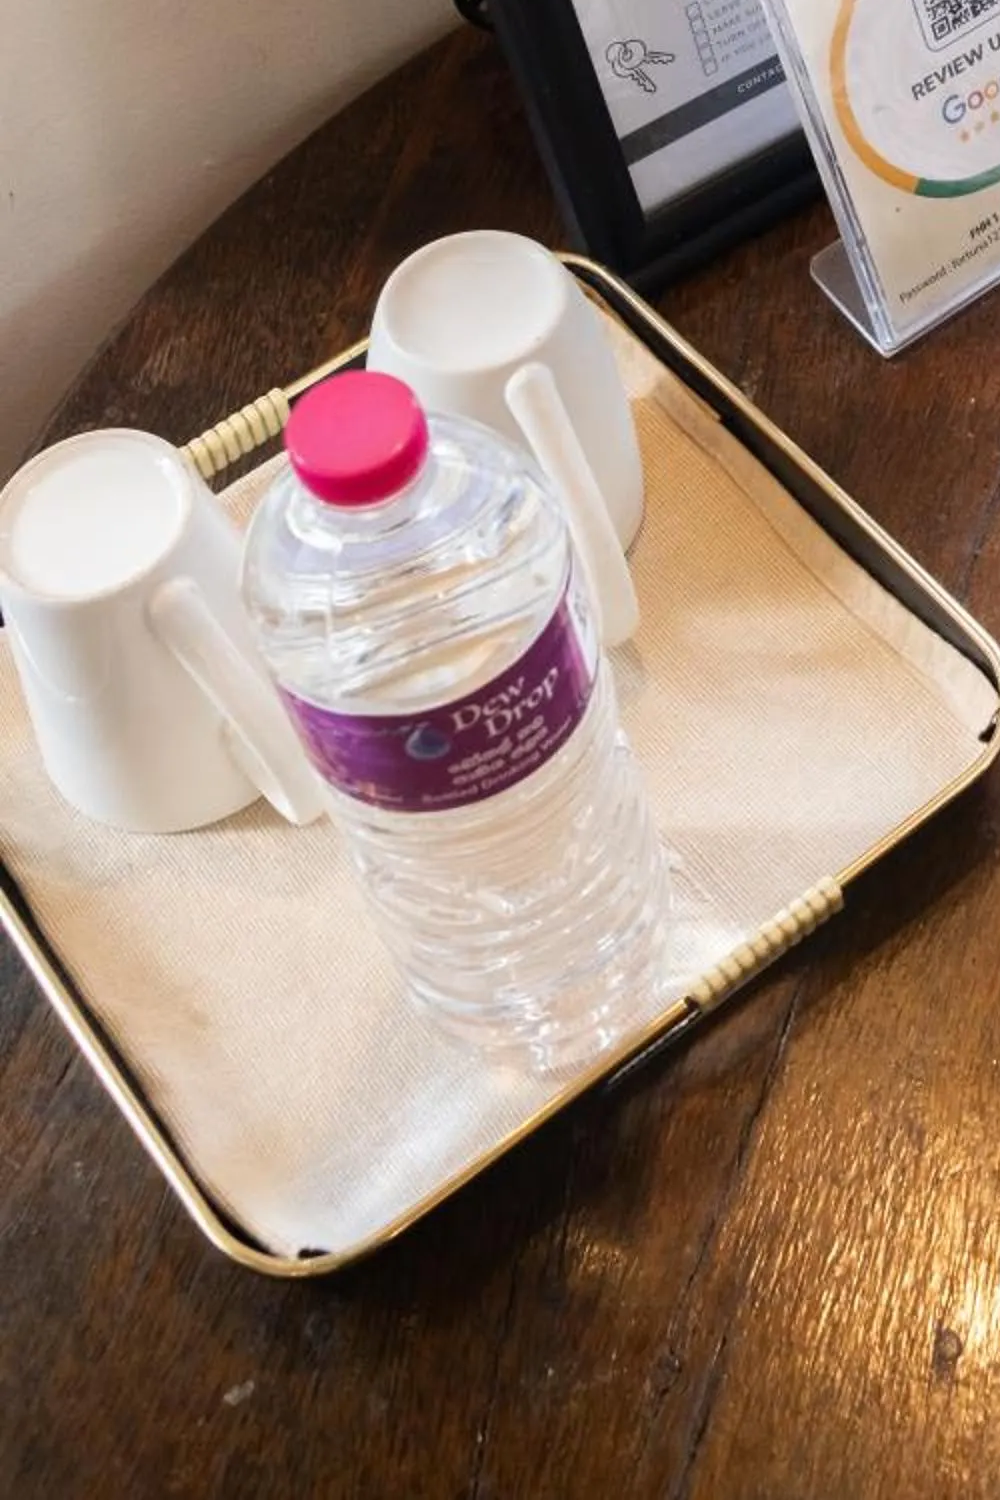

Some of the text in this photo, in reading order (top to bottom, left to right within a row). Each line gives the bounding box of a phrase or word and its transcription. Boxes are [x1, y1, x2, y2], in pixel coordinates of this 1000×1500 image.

[735, 62, 785, 94] CONTAC
[909, 41, 986, 102] REVIEW
[452, 676, 525, 732] Dew
[483, 666, 559, 739] Drop
